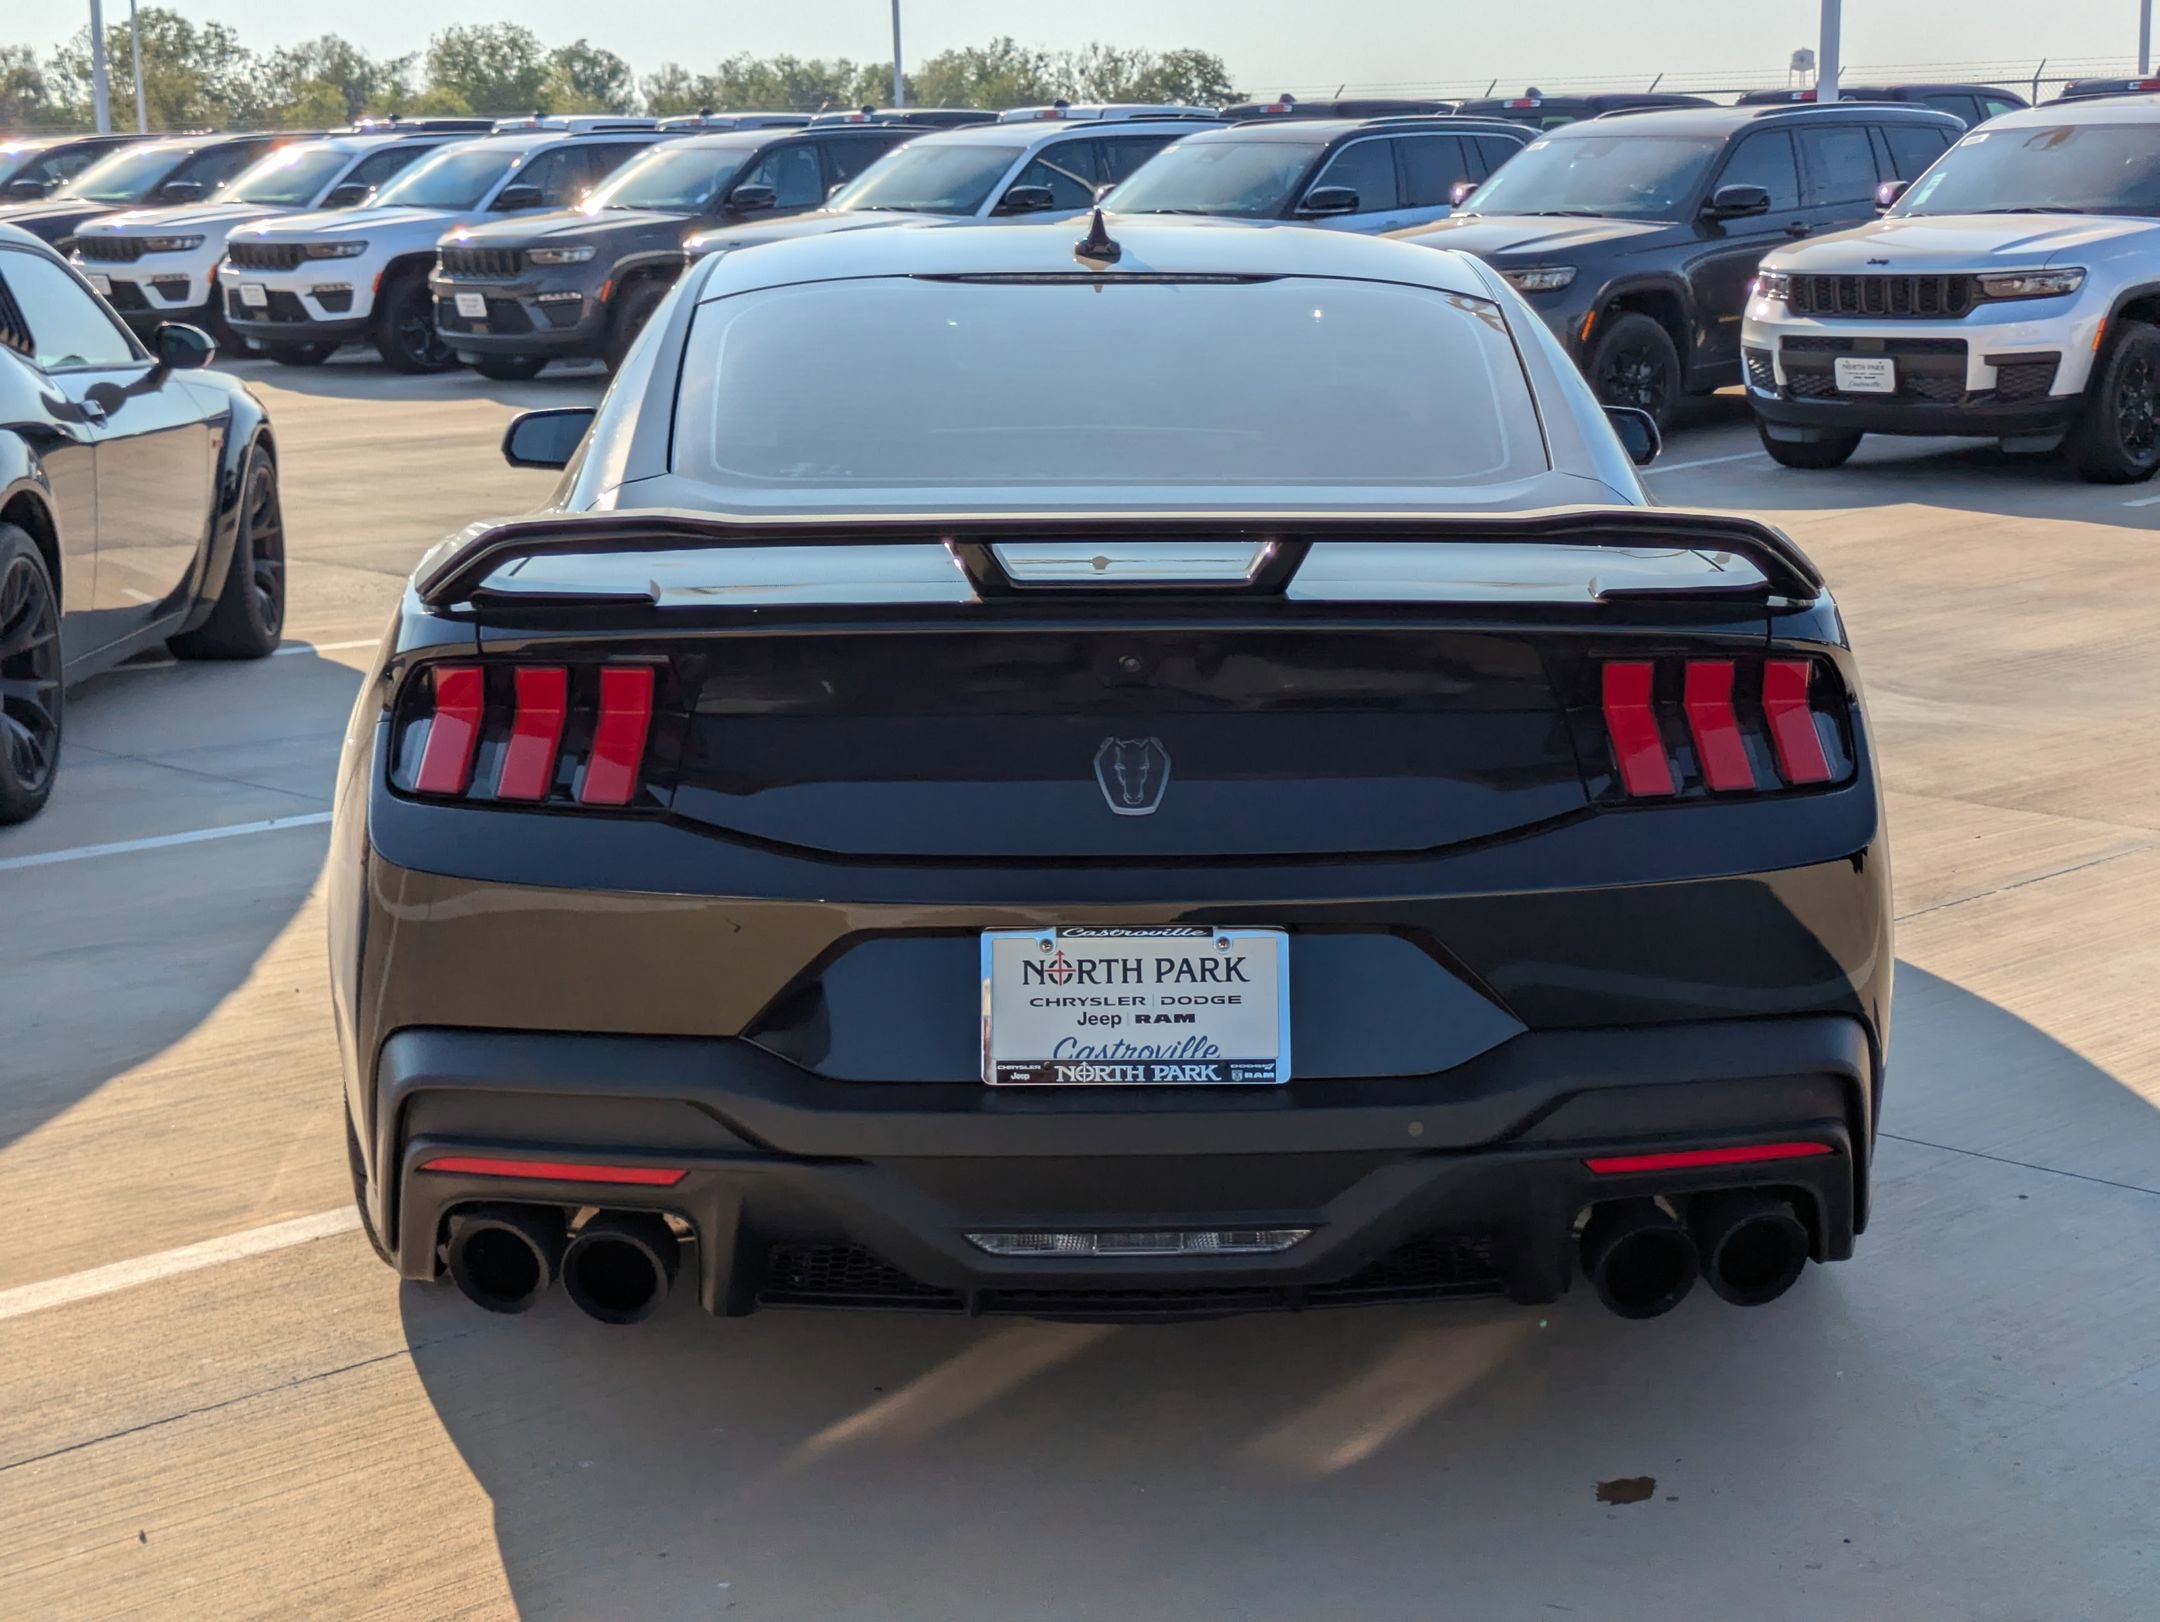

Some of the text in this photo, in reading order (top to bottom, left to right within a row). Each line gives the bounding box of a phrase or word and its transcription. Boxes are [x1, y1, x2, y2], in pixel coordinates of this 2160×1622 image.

[1062, 927, 1208, 938] Castroville
[1022, 956, 1251, 985] NORTH PARK
[1030, 995, 1242, 1007] CHRYSLER DODGE
[1077, 1012, 1196, 1028] Jeep RAM
[1053, 1035, 1221, 1060] Castroville
[1010, 1072, 1031, 1081] Jeep
[1054, 1064, 1222, 1083] NORTH PARK
